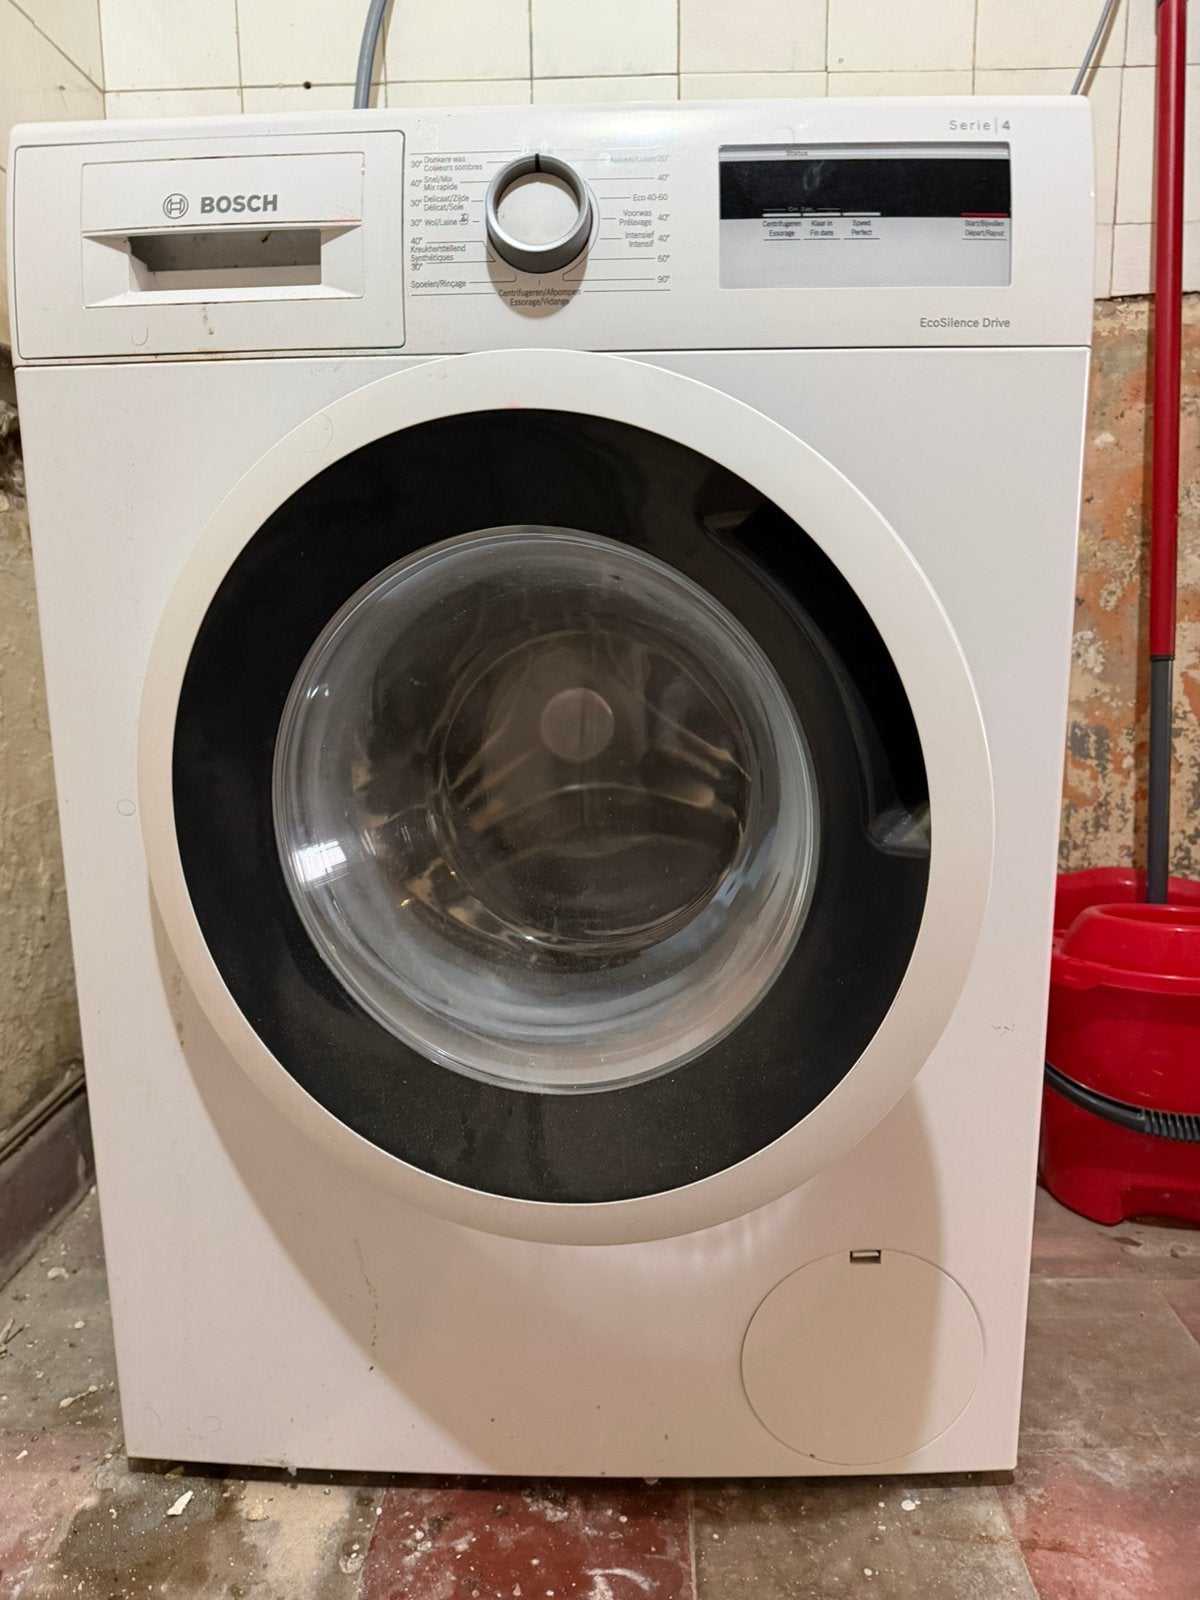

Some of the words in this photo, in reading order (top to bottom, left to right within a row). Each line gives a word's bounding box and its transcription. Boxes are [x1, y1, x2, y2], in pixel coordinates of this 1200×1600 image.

[949, 119, 991, 131] Serie
[1002, 120, 1011, 130] 4
[410, 160, 422, 168] 30°
[410, 179, 422, 187] 40°
[633, 193, 646, 201] Eco
[646, 193, 669, 201] 40-60
[200, 194, 278, 214] BOSCH
[410, 199, 422, 207] 30°
[622, 209, 653, 217] Voorwas
[410, 218, 422, 226] 30°
[424, 218, 457, 226] Wol/Laine
[619, 218, 652, 227] Prélavage
[625, 231, 655, 239] Intensief
[851, 228, 873, 236] Perfect
[410, 236, 423, 244] 40°
[657, 234, 671, 242] 40°
[628, 240, 654, 248] Intensif
[410, 244, 467, 253] Kreukherstellend
[410, 254, 454, 263] Synthétiques
[657, 254, 671, 262] 60°
[411, 263, 424, 271] 30°
[657, 275, 671, 284] 90°
[920, 317, 980, 328] EcoSilence
[982, 317, 1011, 328] Drive
